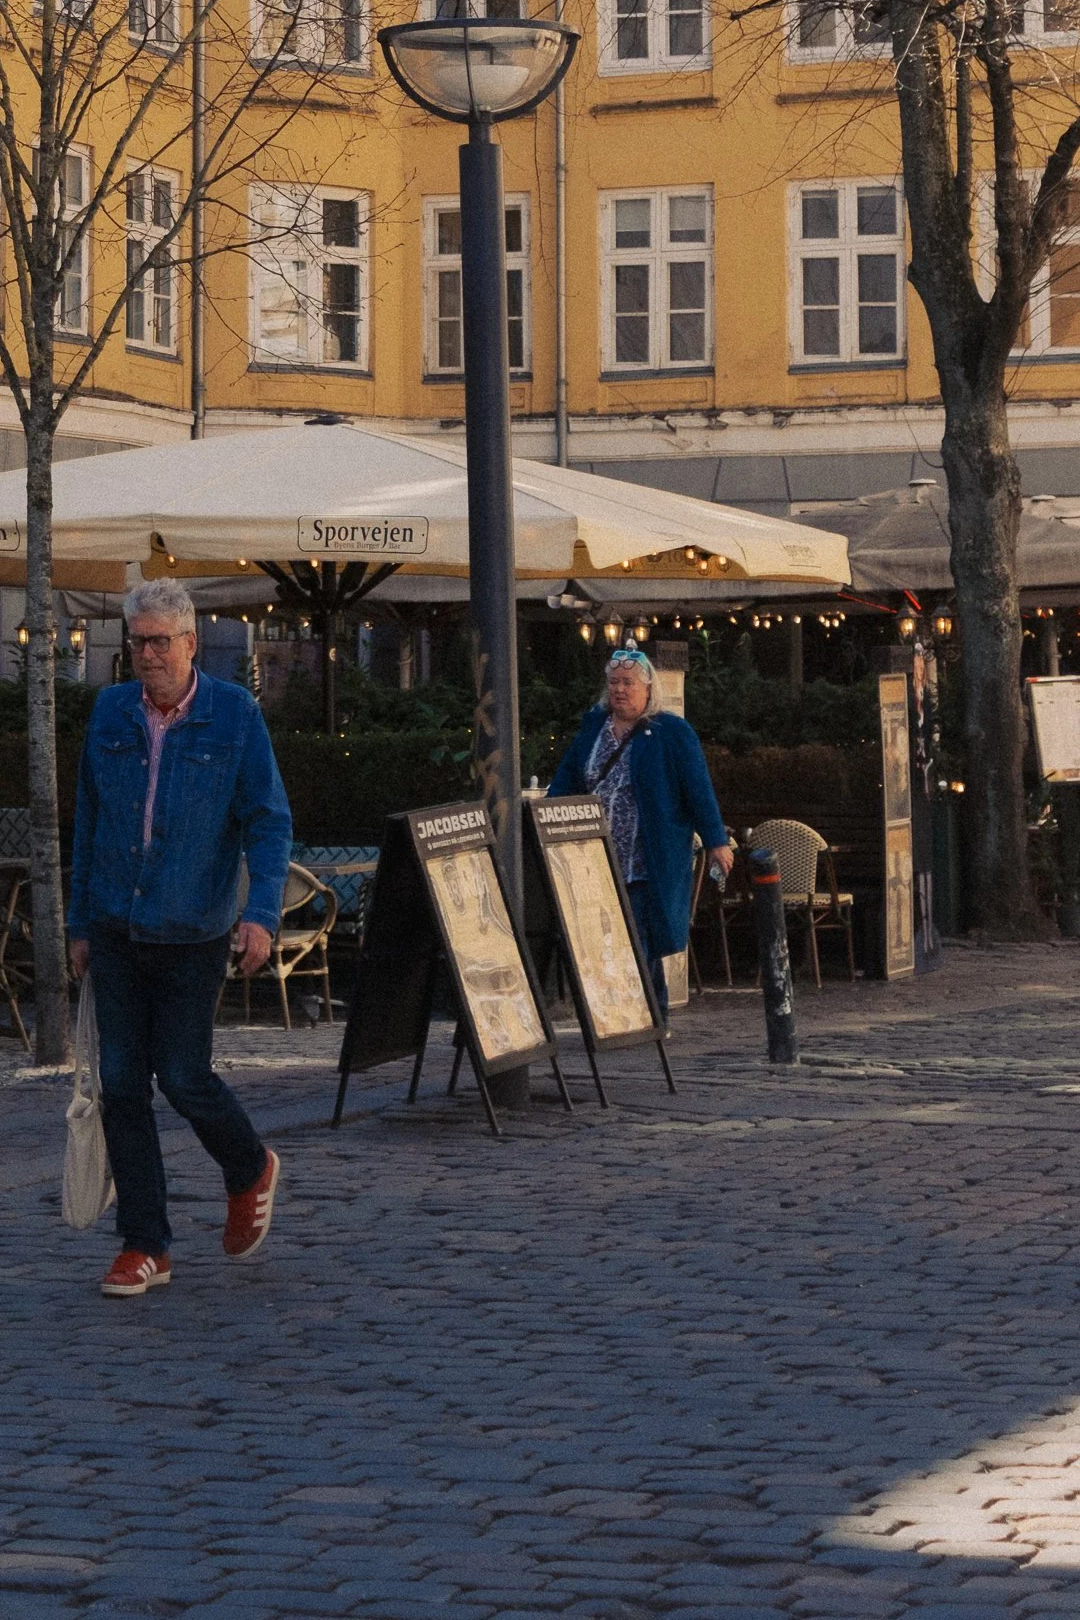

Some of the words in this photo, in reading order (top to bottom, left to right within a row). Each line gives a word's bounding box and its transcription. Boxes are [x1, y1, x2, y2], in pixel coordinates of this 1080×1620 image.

[313, 519, 414, 548] Sporvejen
[389, 542, 401, 550] Bar
[417, 809, 486, 839] JACOBSEN
[538, 803, 601, 824] JACOBSEN
